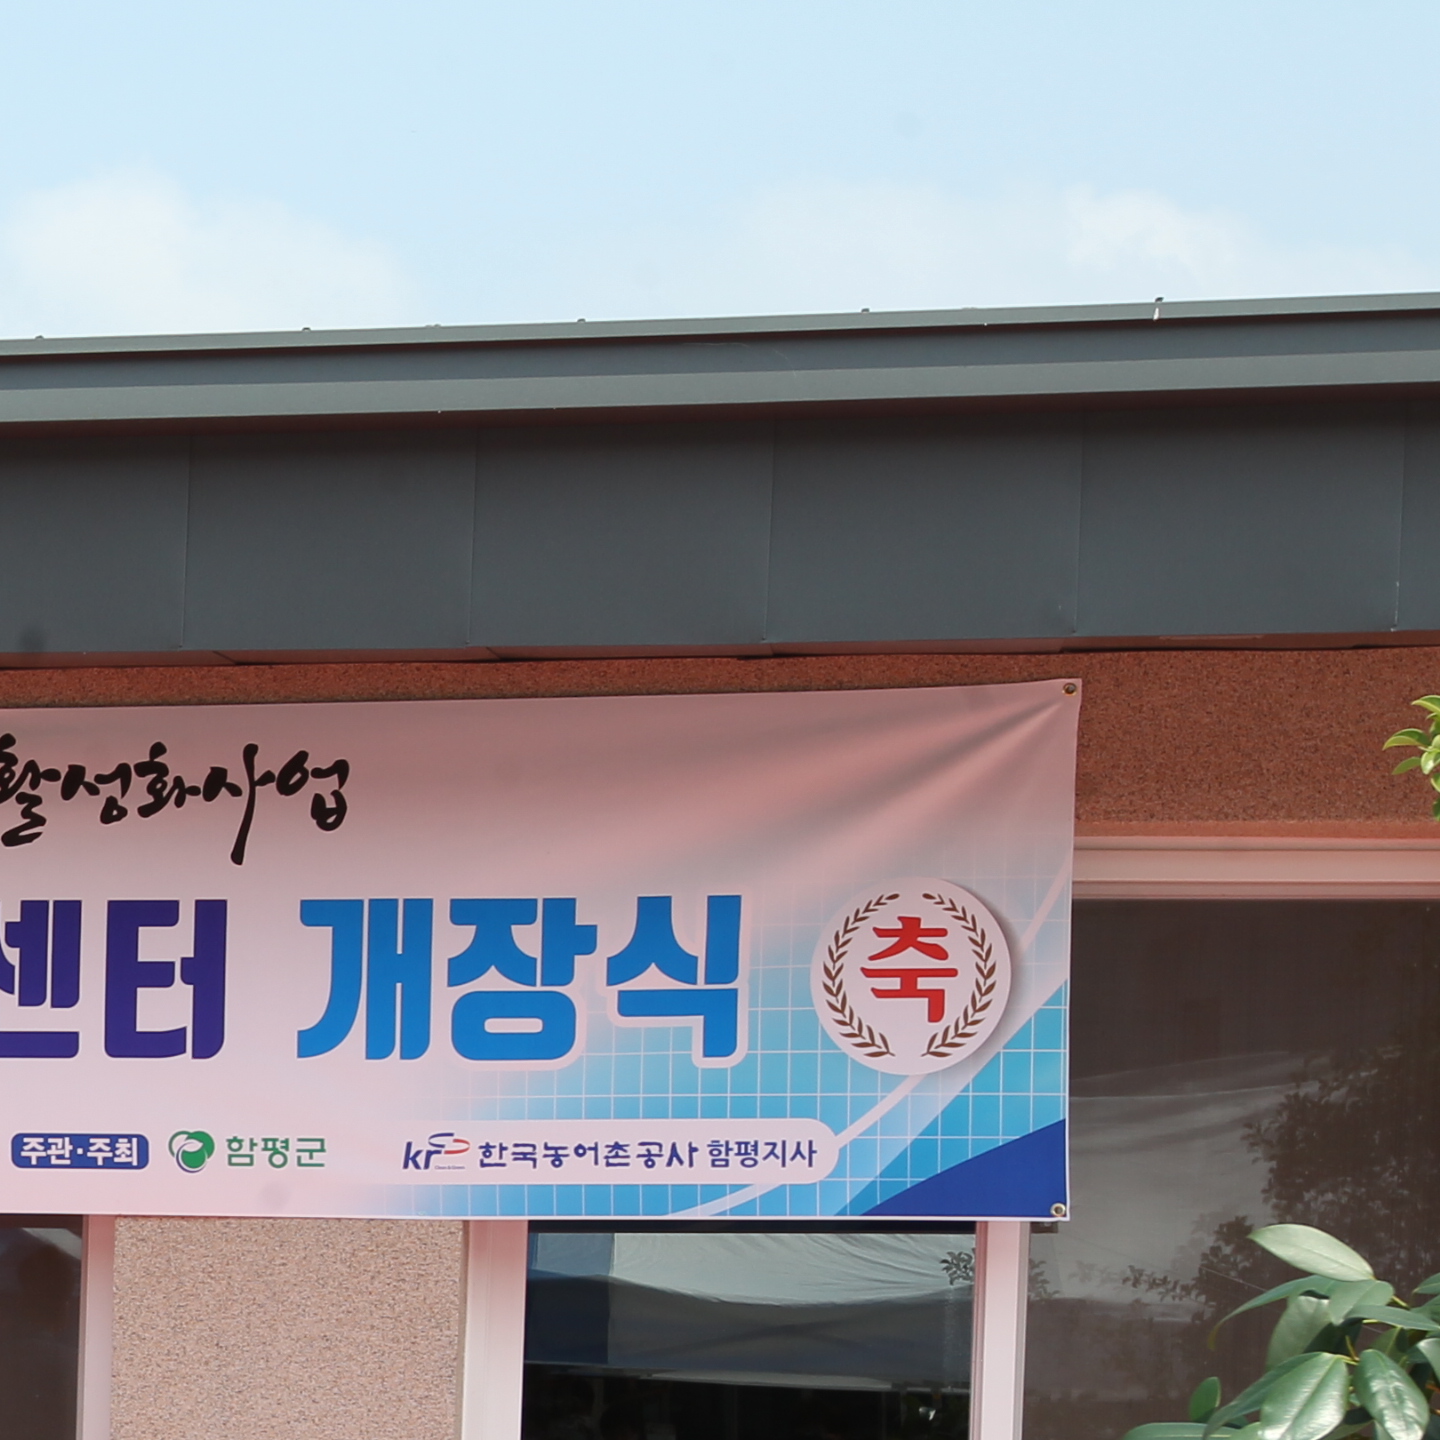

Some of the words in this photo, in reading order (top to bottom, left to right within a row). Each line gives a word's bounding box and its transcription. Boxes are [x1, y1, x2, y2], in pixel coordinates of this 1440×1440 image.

[296, 894, 743, 1061] 개장식
[860, 915, 959, 1024] 축
[226, 1135, 328, 1169] 함평군
[478, 1141, 699, 1169] 한국농어촌공사
[707, 1139, 818, 1169] 함평지사
